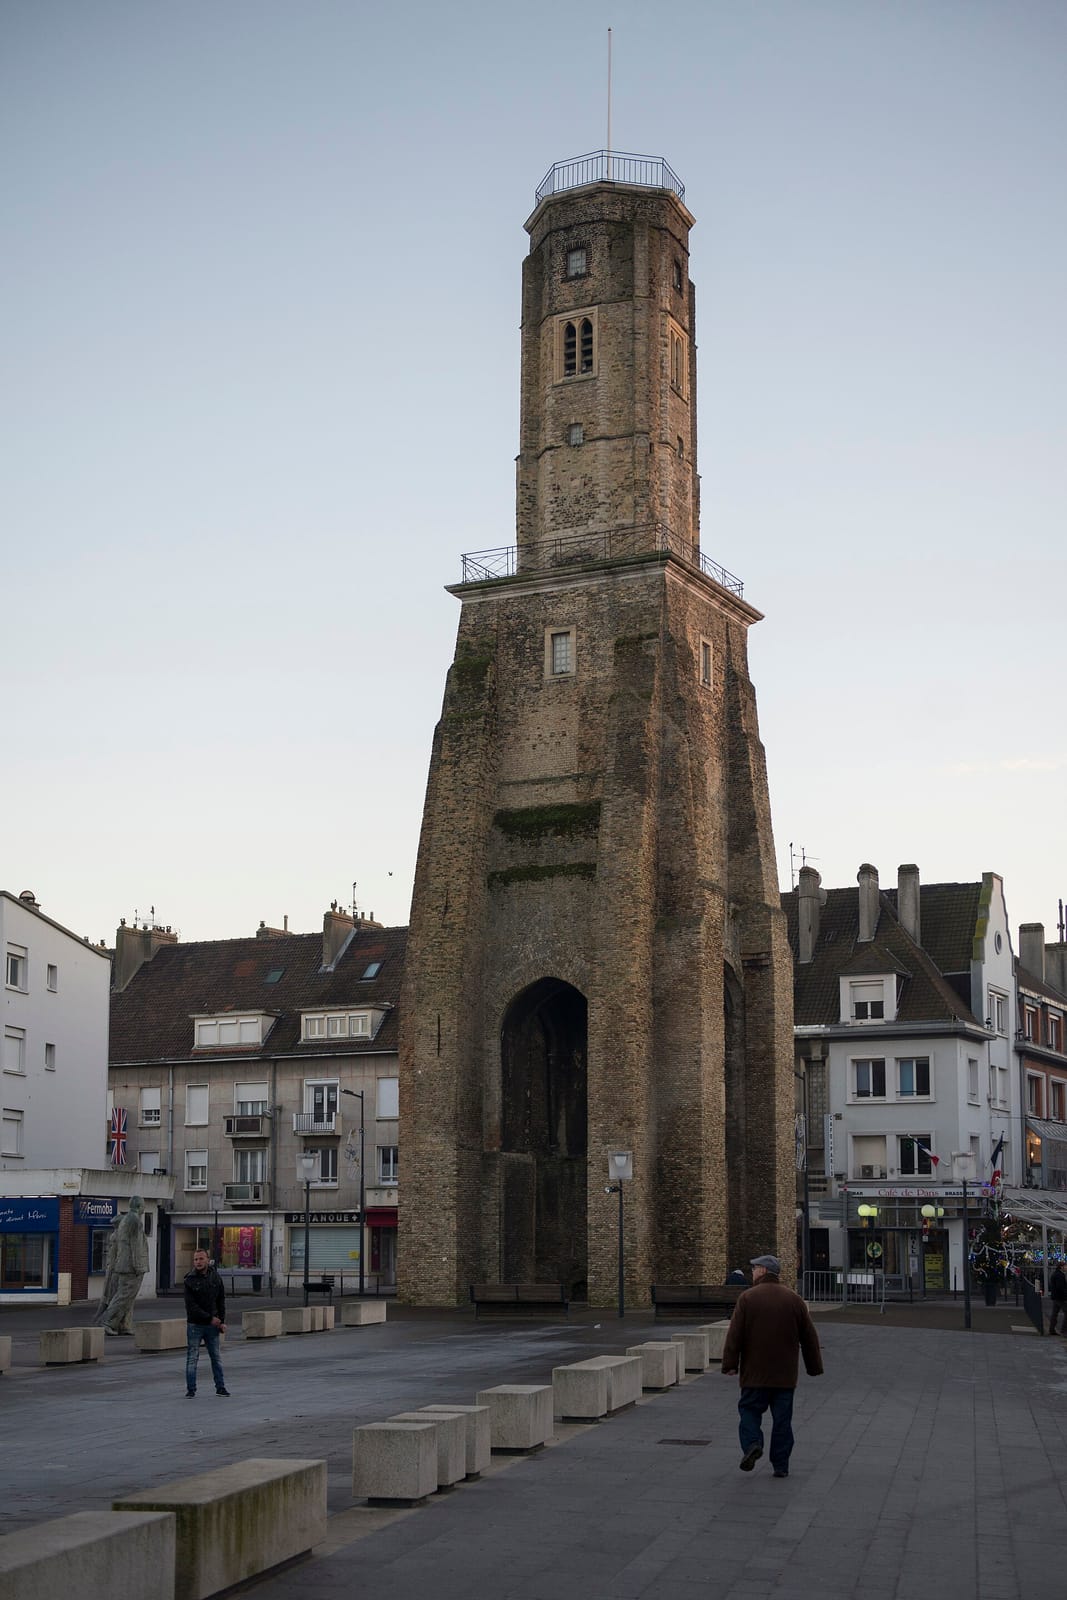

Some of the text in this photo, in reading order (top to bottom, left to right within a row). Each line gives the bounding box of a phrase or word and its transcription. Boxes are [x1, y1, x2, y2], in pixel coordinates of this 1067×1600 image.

[878, 1188, 898, 1197] Café
[901, 1188, 913, 1197] de
[917, 1188, 940, 1197] Paris
[87, 1201, 113, 1215] Fermoba
